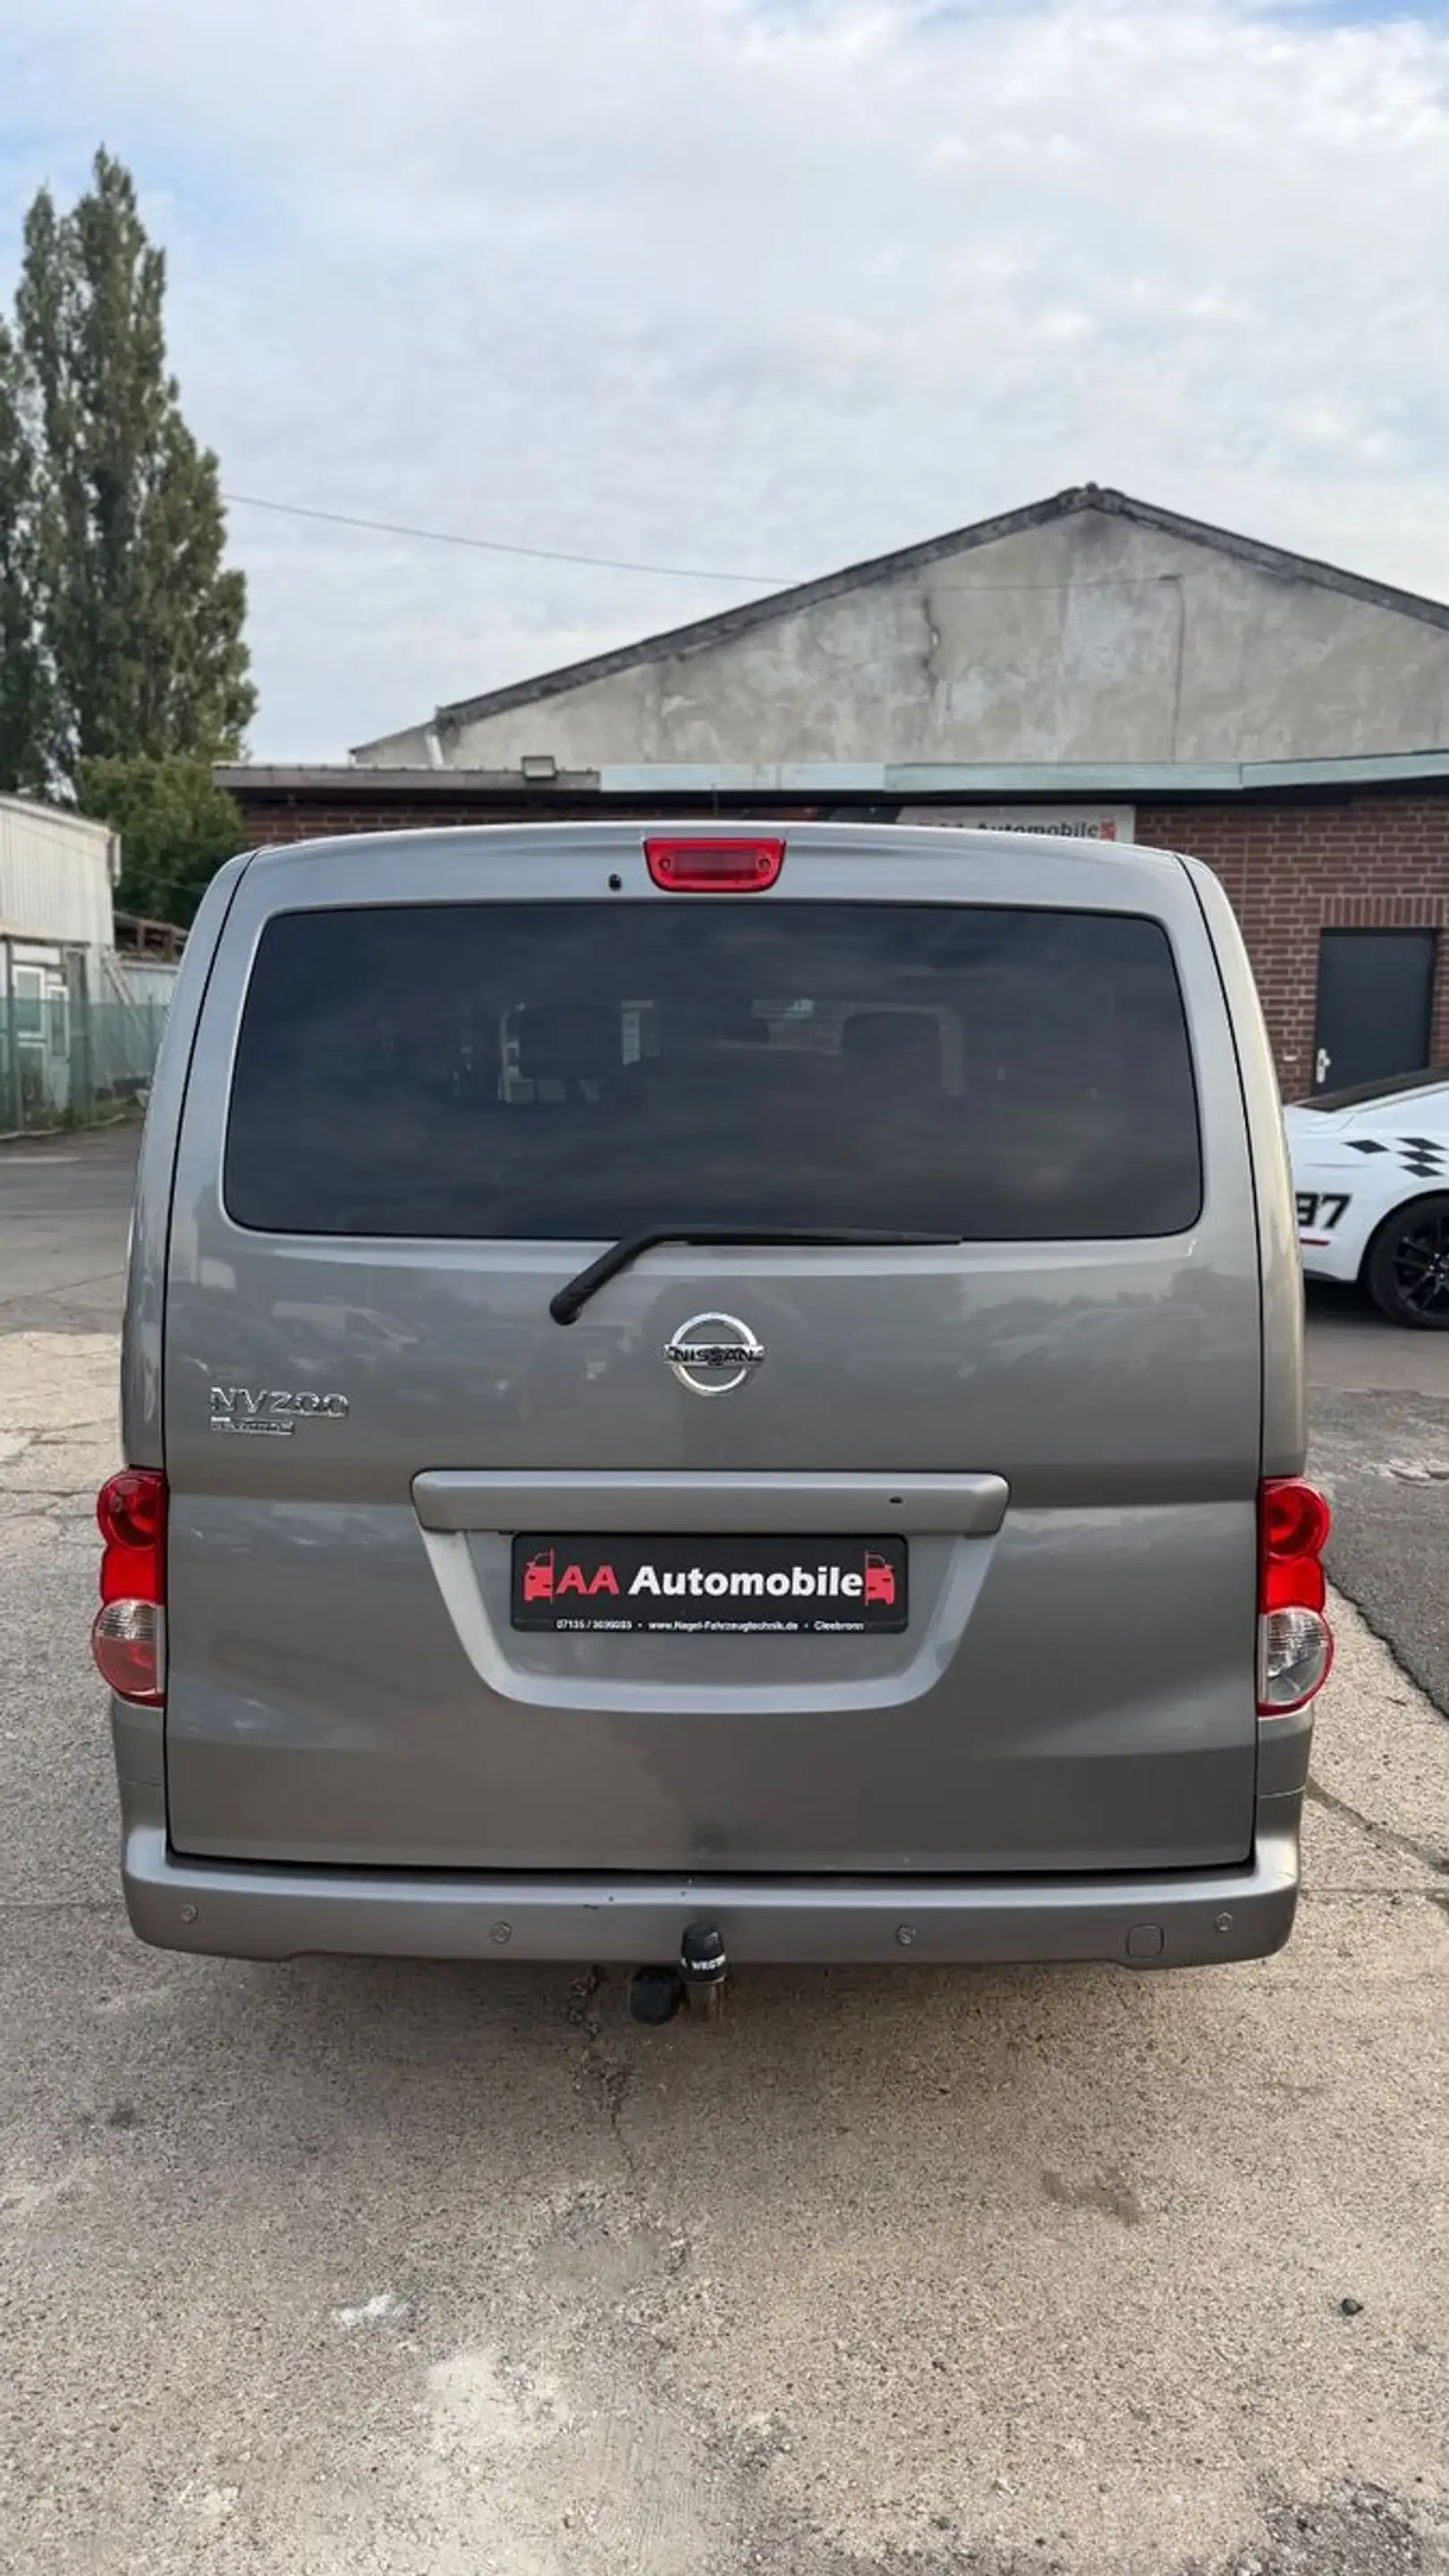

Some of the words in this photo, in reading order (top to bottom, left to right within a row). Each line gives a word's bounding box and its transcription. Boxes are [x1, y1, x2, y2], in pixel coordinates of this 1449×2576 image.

[671, 1347, 754, 1362] NISSAN
[210, 1386, 349, 1419] NV200
[555, 1564, 620, 1596] AA
[628, 1565, 863, 1597] Automobile
